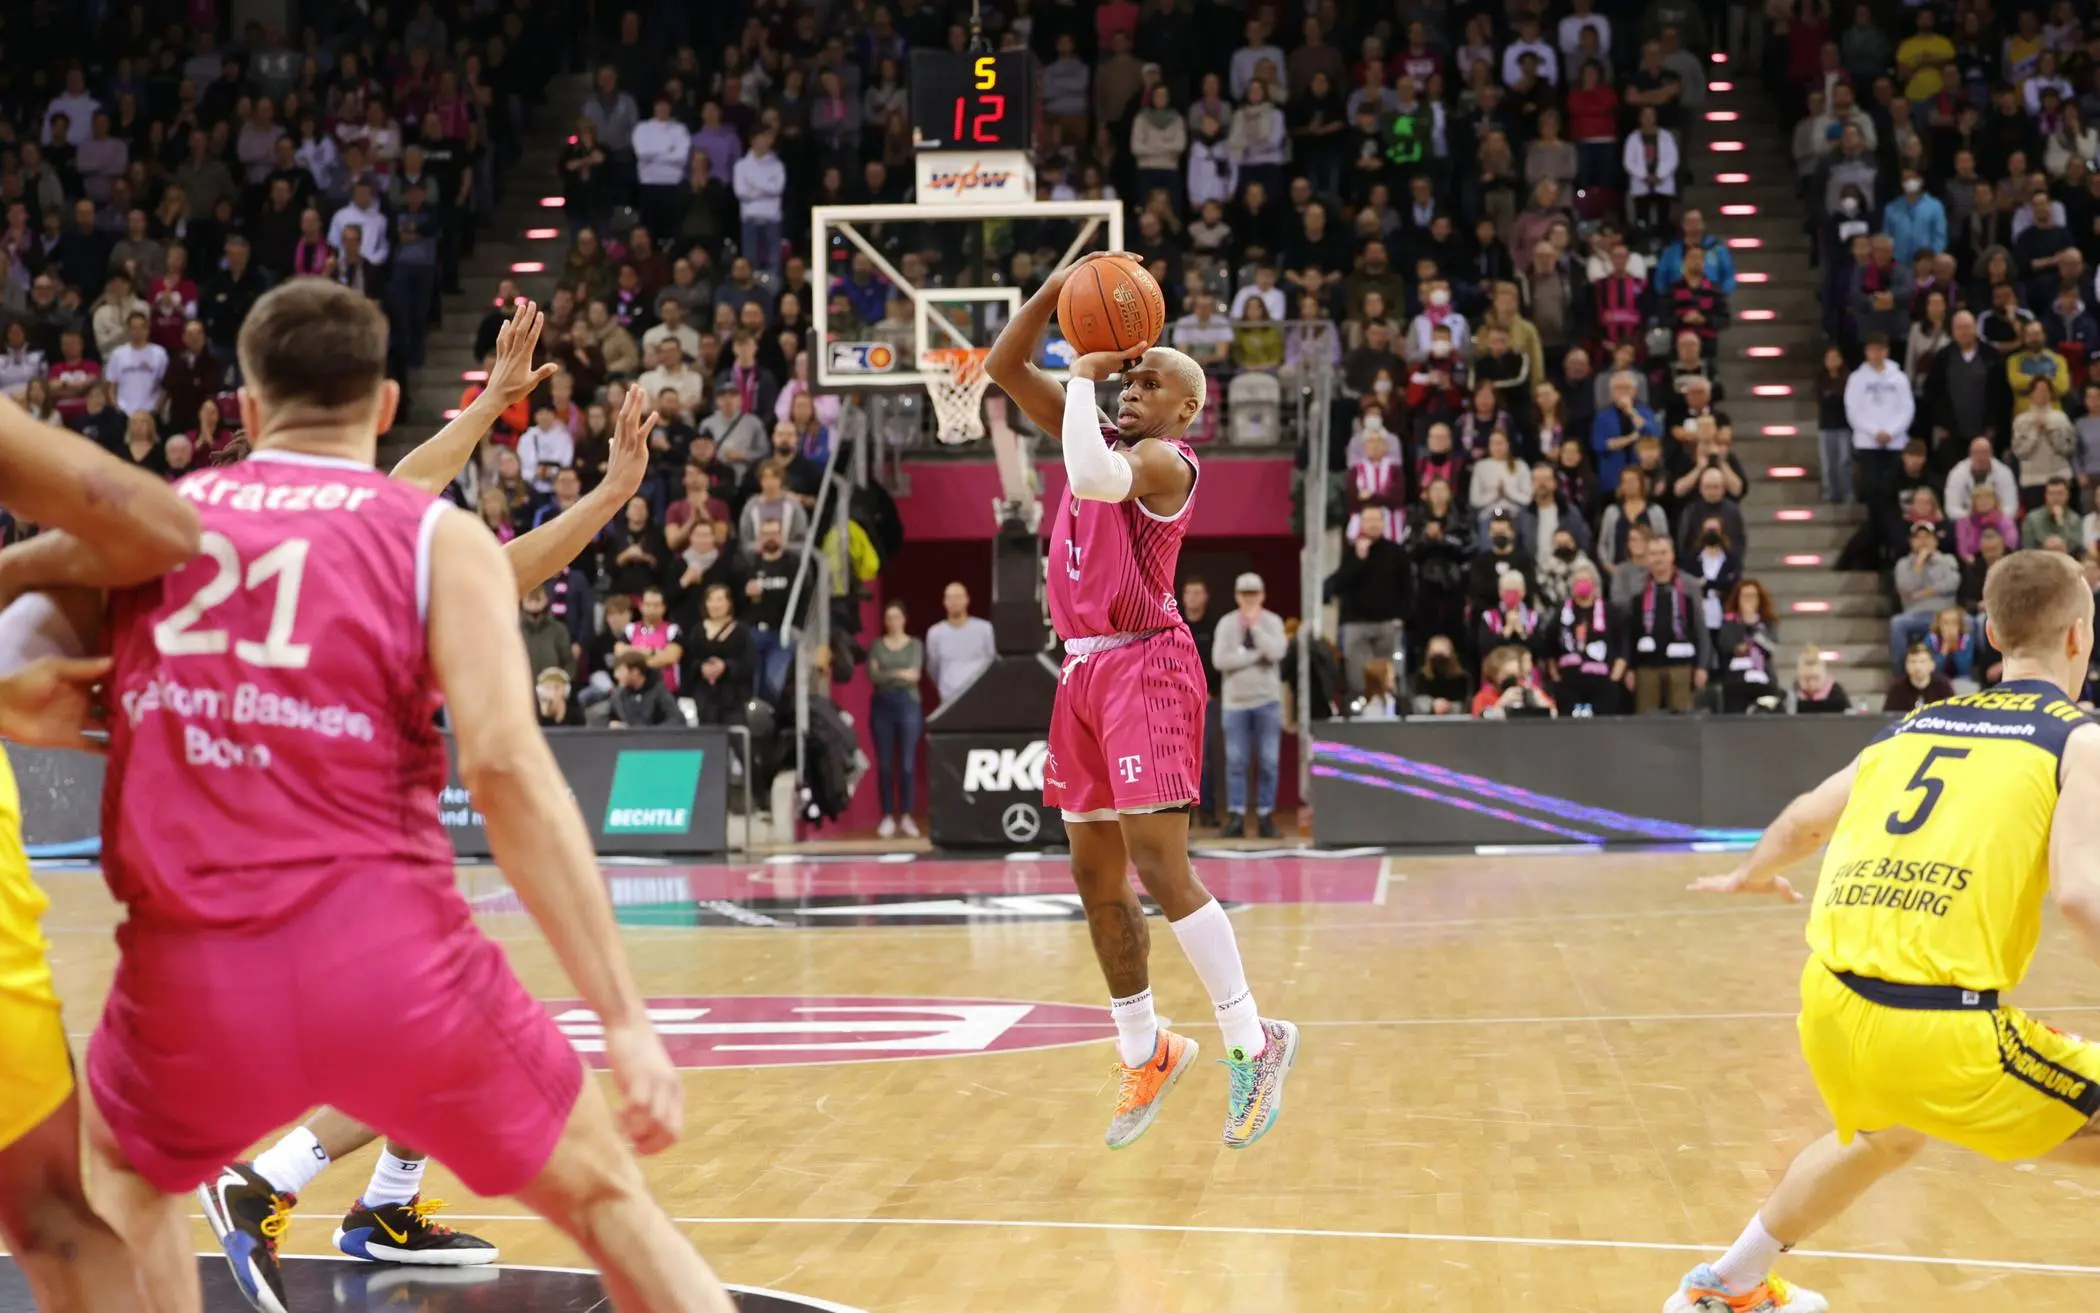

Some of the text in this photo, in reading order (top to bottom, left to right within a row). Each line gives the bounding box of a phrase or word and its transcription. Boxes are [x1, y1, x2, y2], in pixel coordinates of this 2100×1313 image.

[974, 56, 997, 90] 5
[953, 94, 1005, 143] 12
[175, 472, 377, 514] Kratzer
[153, 530, 311, 669] 21
[1914, 717, 2036, 736] CleverReach
[1885, 745, 1973, 835] 5
[609, 808, 687, 827] BECHTLE
[1113, 992, 1151, 1008] SPALDIN
